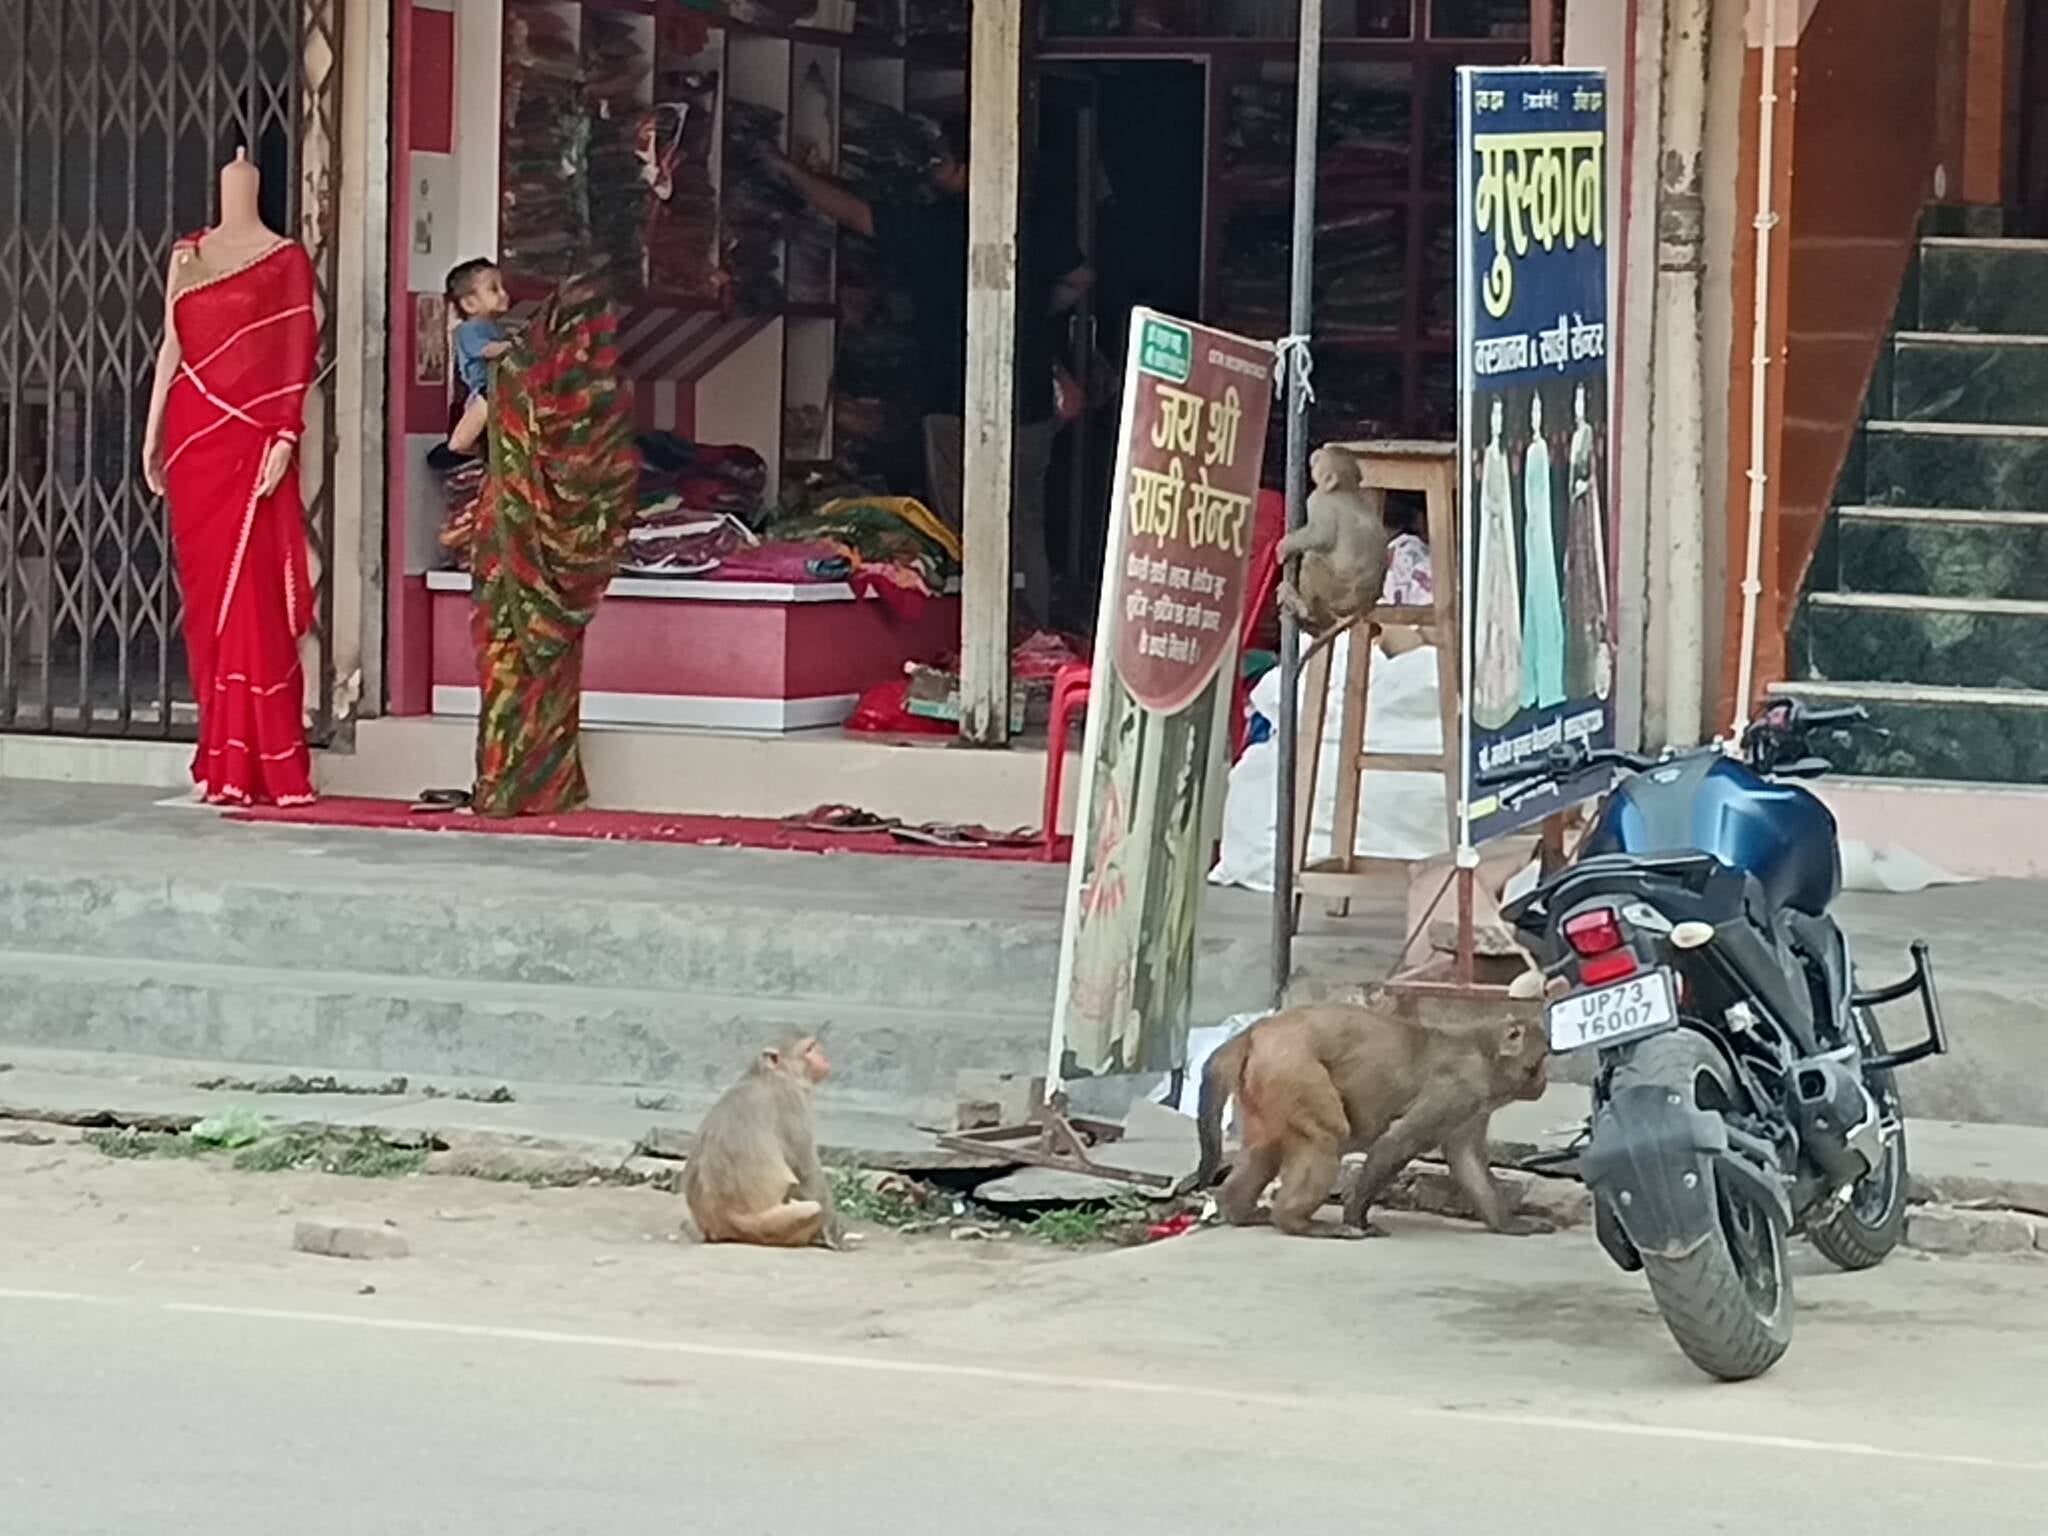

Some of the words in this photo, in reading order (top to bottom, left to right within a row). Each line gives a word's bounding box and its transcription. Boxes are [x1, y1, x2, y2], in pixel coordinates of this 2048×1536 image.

[1474, 131, 1604, 318] मुस्कान
[1151, 383, 1204, 456] जय
[1205, 385, 1243, 467] श्री
[1129, 456, 1187, 549] साड़ी
[1186, 466, 1252, 558] सेन्टर
[1576, 1001, 1653, 1041] Y6007
[1581, 982, 1644, 1018] UP73
